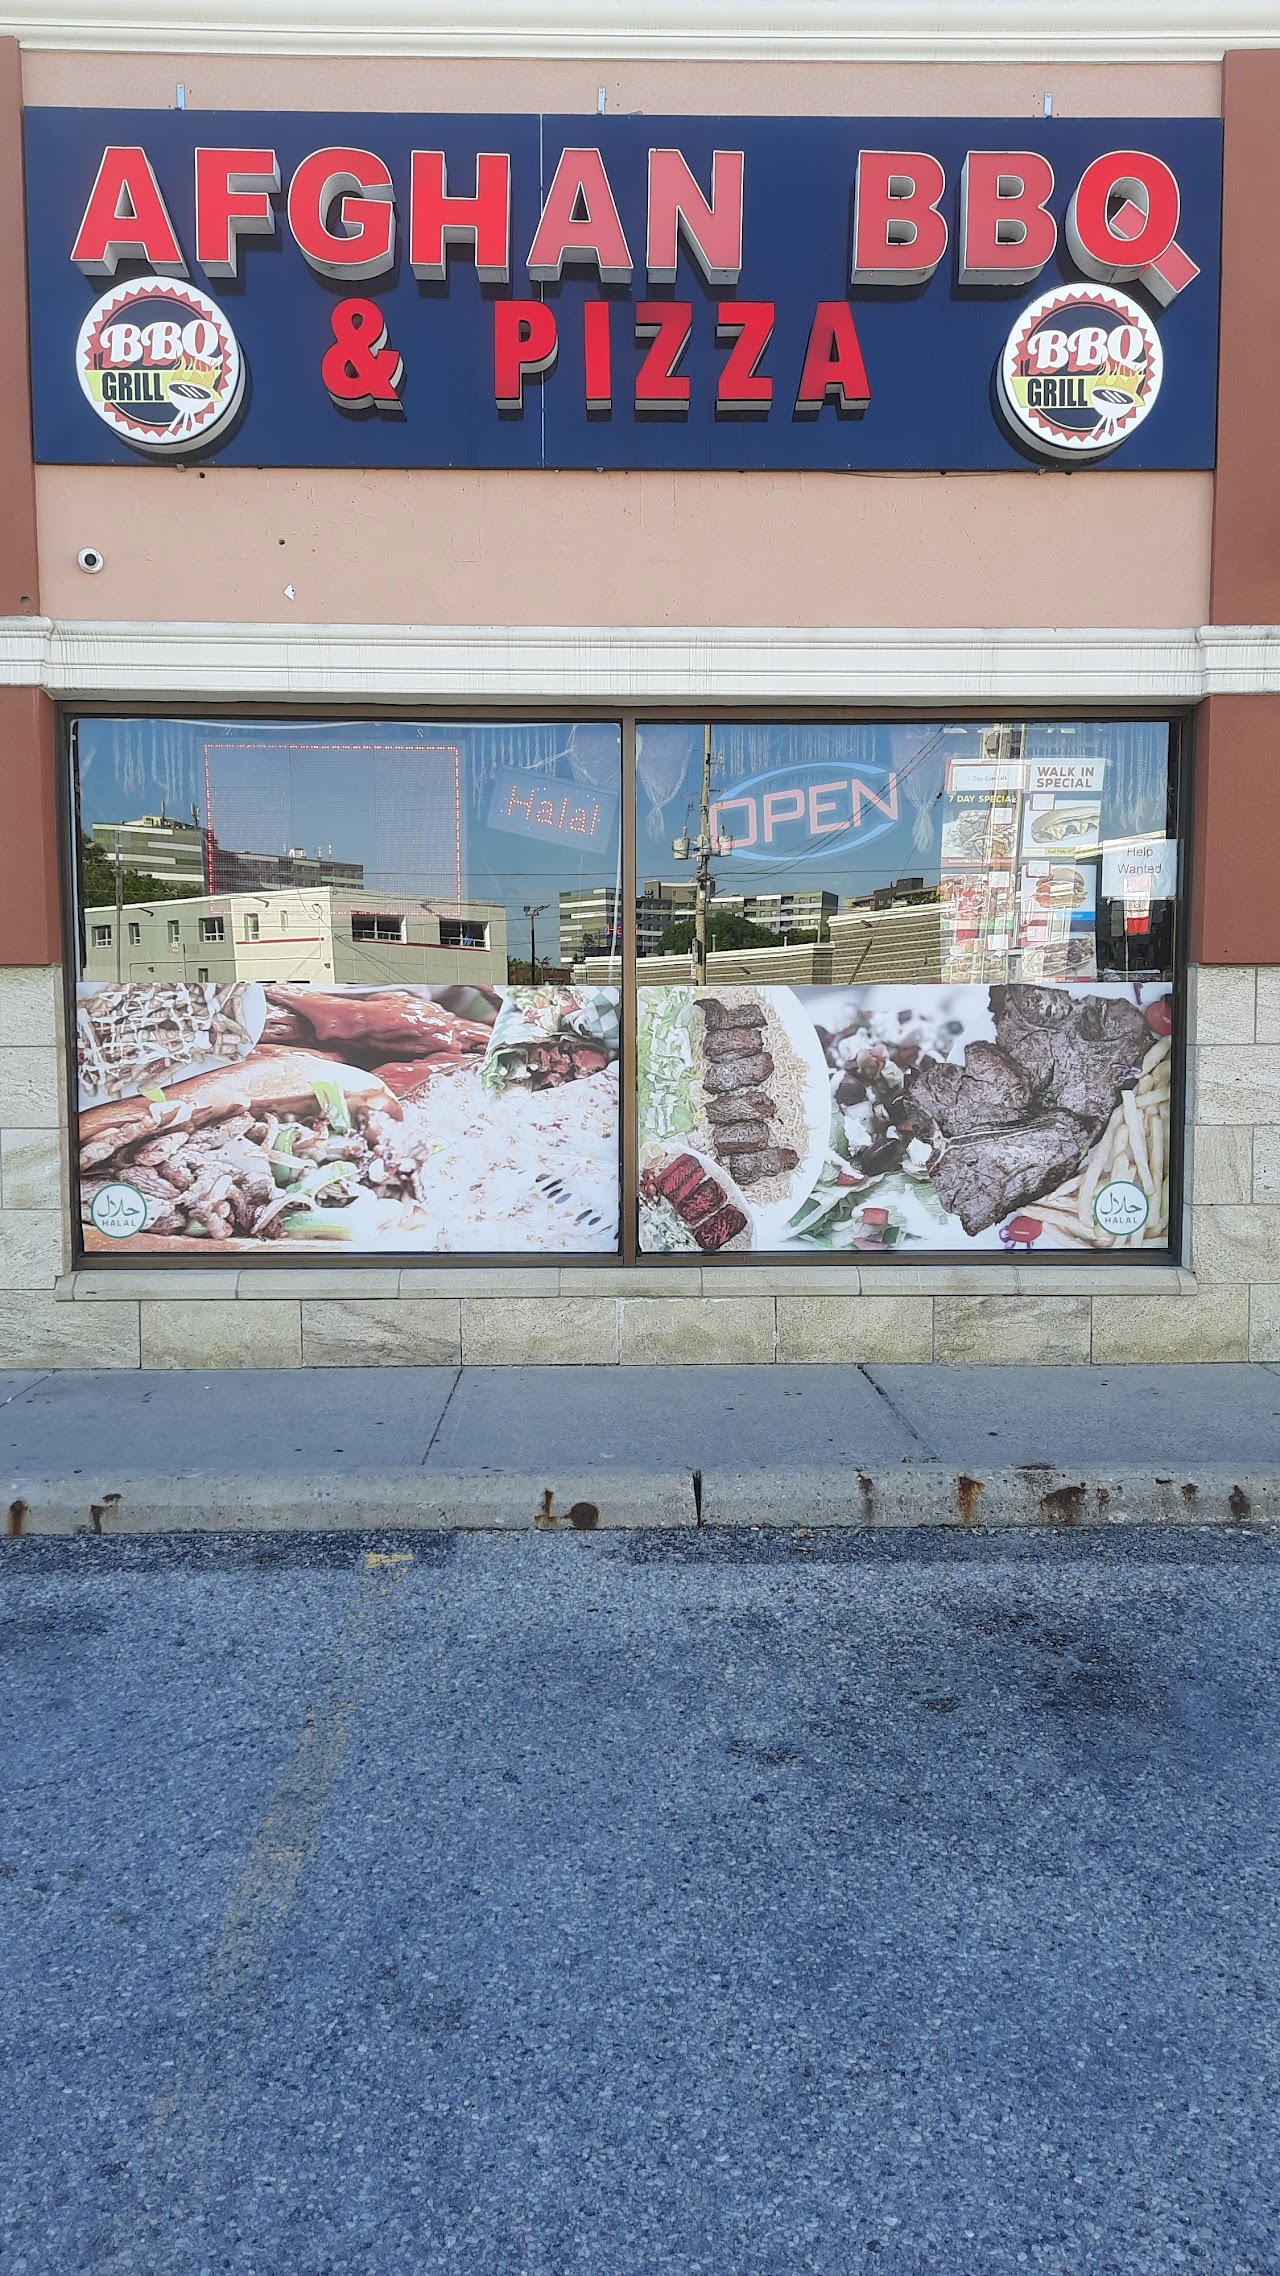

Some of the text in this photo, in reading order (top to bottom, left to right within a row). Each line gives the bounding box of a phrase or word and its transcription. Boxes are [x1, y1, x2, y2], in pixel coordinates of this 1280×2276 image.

[70, 146, 1200, 293] AFGHAN BBQ
[100, 319, 224, 366] BBQ
[321, 298, 872, 402] & PIZZA
[1027, 325, 1148, 371] BBQ
[101, 372, 165, 401] GRILL
[1027, 378, 1088, 407] GRILL
[1036, 766, 1095, 778] WALK IN
[1036, 778, 1093, 789] SPECIAL
[507, 784, 600, 836] Halal
[709, 772, 899, 851] OPEN
[948, 795, 955, 803] 7
[957, 795, 975, 803] DAY
[1127, 847, 1153, 858] Help
[1117, 863, 1162, 874] Wanted
[97, 1194, 140, 1217] حلال
[1101, 1192, 1143, 1215] حلال
[102, 1219, 136, 1227] HALAL
